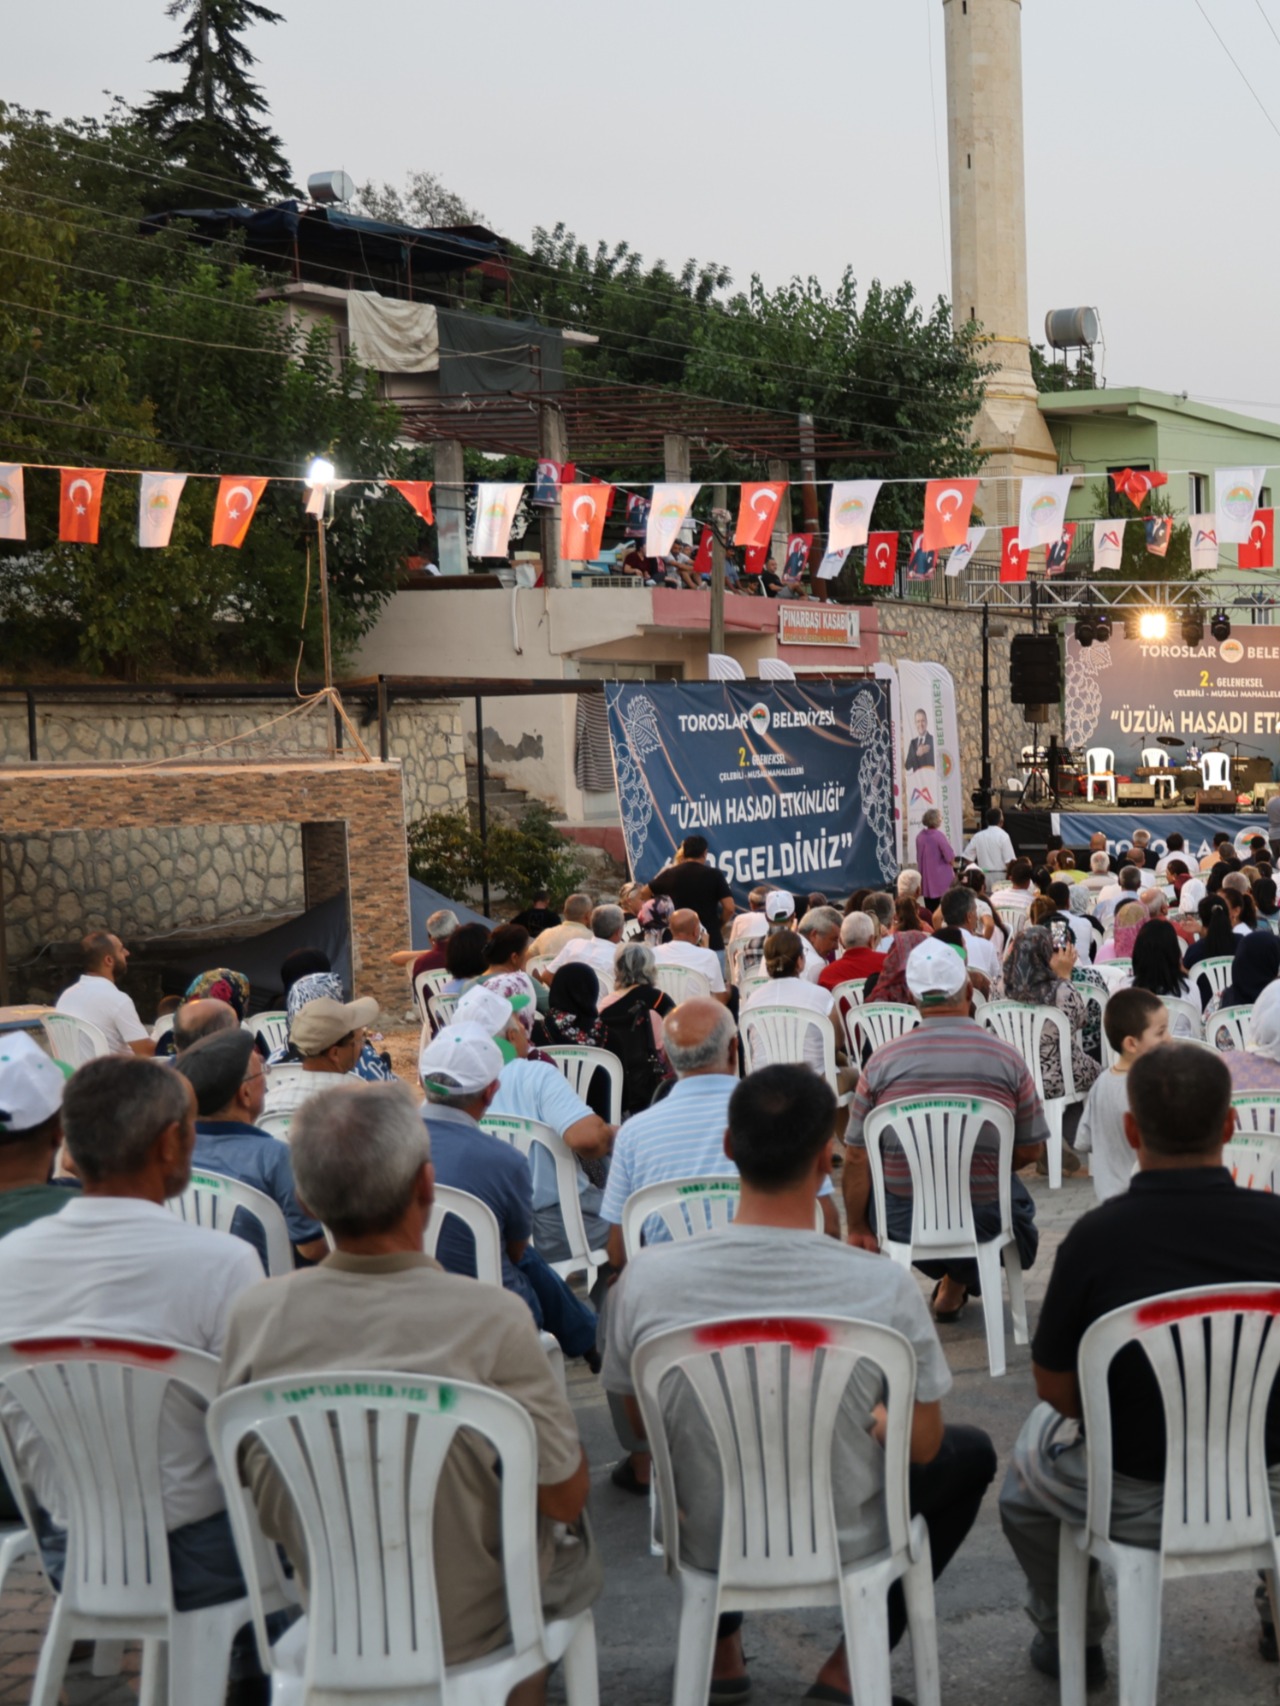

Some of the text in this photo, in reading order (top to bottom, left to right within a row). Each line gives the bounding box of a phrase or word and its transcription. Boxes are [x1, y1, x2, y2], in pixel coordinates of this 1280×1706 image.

[1139, 644, 1217, 659] TOROSLAR
[1199, 671, 1264, 688] 2. GELENEKSEL
[1173, 688, 1205, 698] ÇELEBİLİ
[1210, 689, 1239, 698] MUSALI
[678, 706, 836, 732] TOROSLAR BELEDİYESİ
[1181, 710, 1248, 734] HASADI
[738, 747, 750, 767] 2.
[725, 794, 777, 824] HASADI
